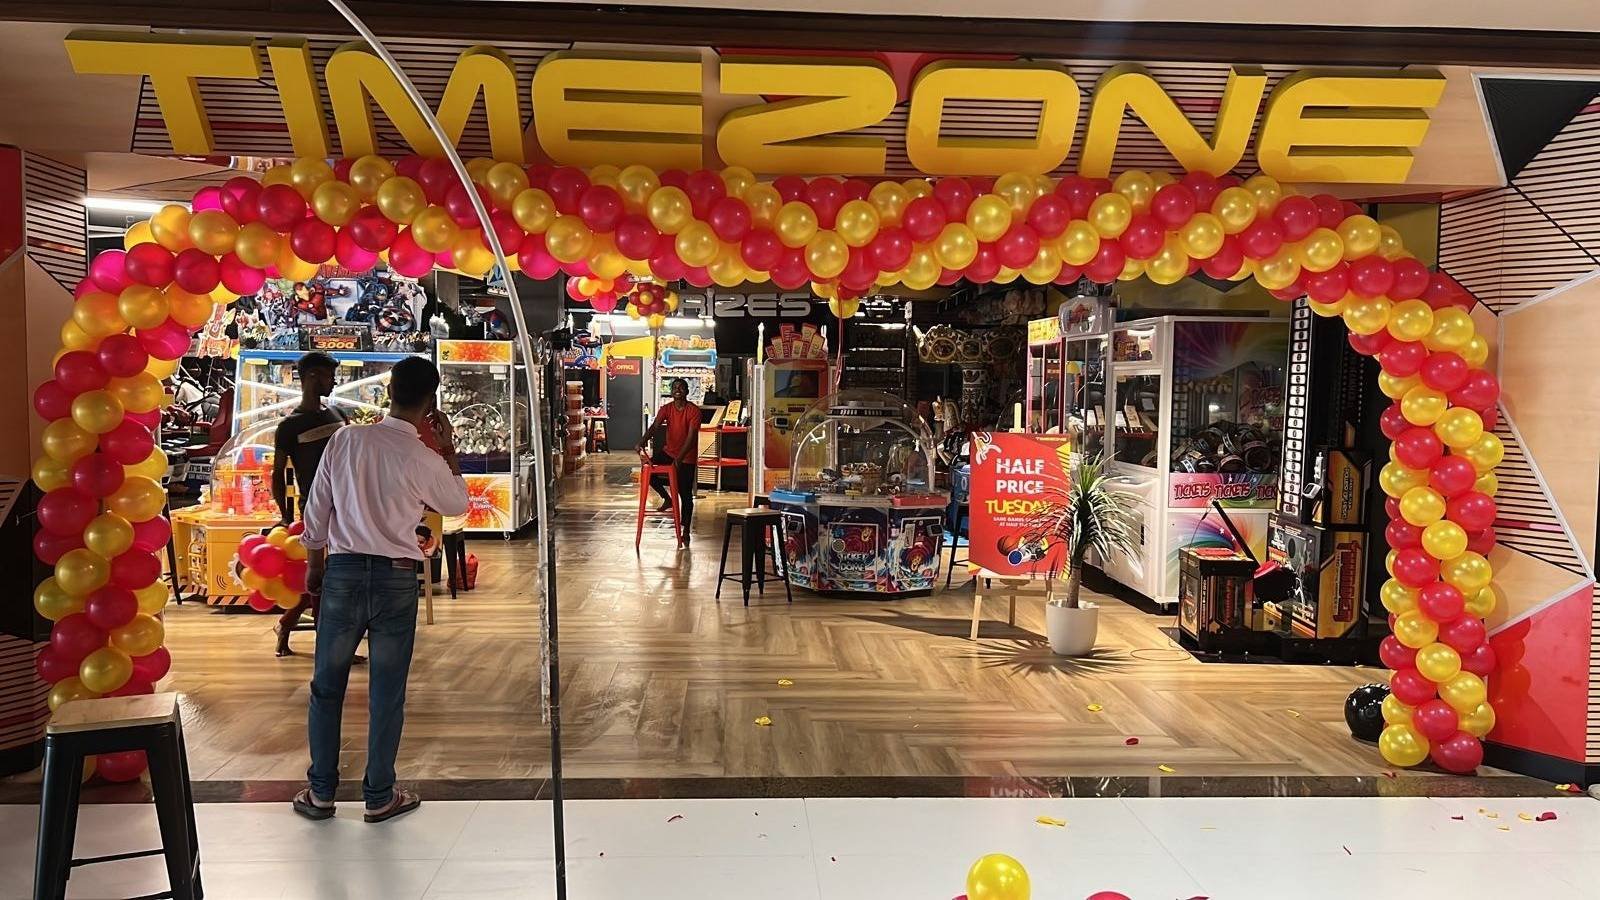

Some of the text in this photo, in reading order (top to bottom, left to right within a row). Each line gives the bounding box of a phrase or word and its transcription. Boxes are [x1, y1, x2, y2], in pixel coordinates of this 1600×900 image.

[65, 30, 1446, 184] TIMEZONE
[678, 288, 811, 317] RIZES
[996, 458, 1044, 475] HALF
[996, 480, 1044, 494] PRICE
[1174, 482, 1277, 500] TICKETS TICKETS TICK
